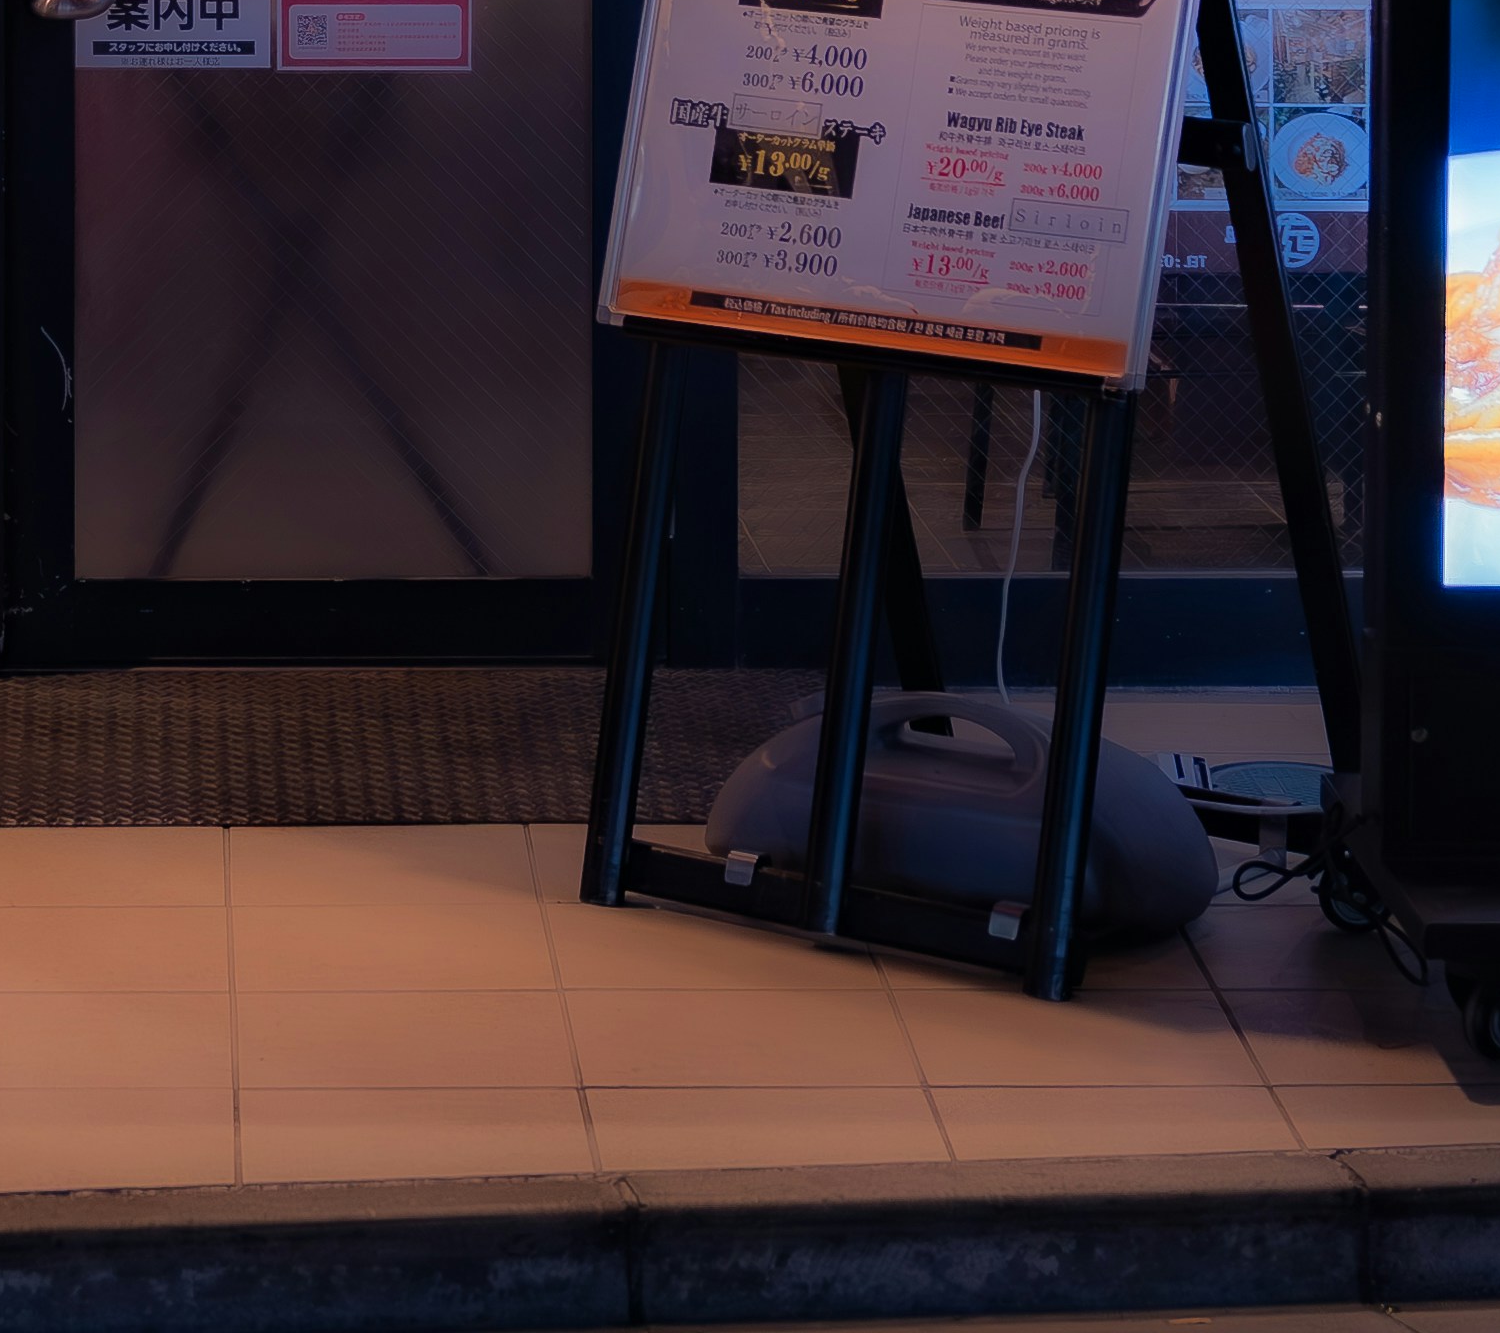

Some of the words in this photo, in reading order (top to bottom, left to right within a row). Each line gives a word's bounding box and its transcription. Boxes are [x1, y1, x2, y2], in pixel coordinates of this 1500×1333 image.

[793, 44, 867, 70] ¥4,000
[790, 72, 863, 97] ¥6,000
[670, 98, 729, 129] 国産牛
[735, 102, 817, 127] サーロイン
[823, 119, 886, 145] ステーキ
[947, 111, 992, 133] Wagyu
[995, 117, 1017, 135] Rib
[1020, 119, 1042, 138] Eye
[1046, 121, 1085, 141] Steak
[738, 149, 832, 182] ¥13.00/g
[907, 203, 970, 226] Japanese
[974, 211, 1004, 230] Beef
[767, 221, 841, 249] ¥2,600
[764, 249, 837, 277] ¥3,900
